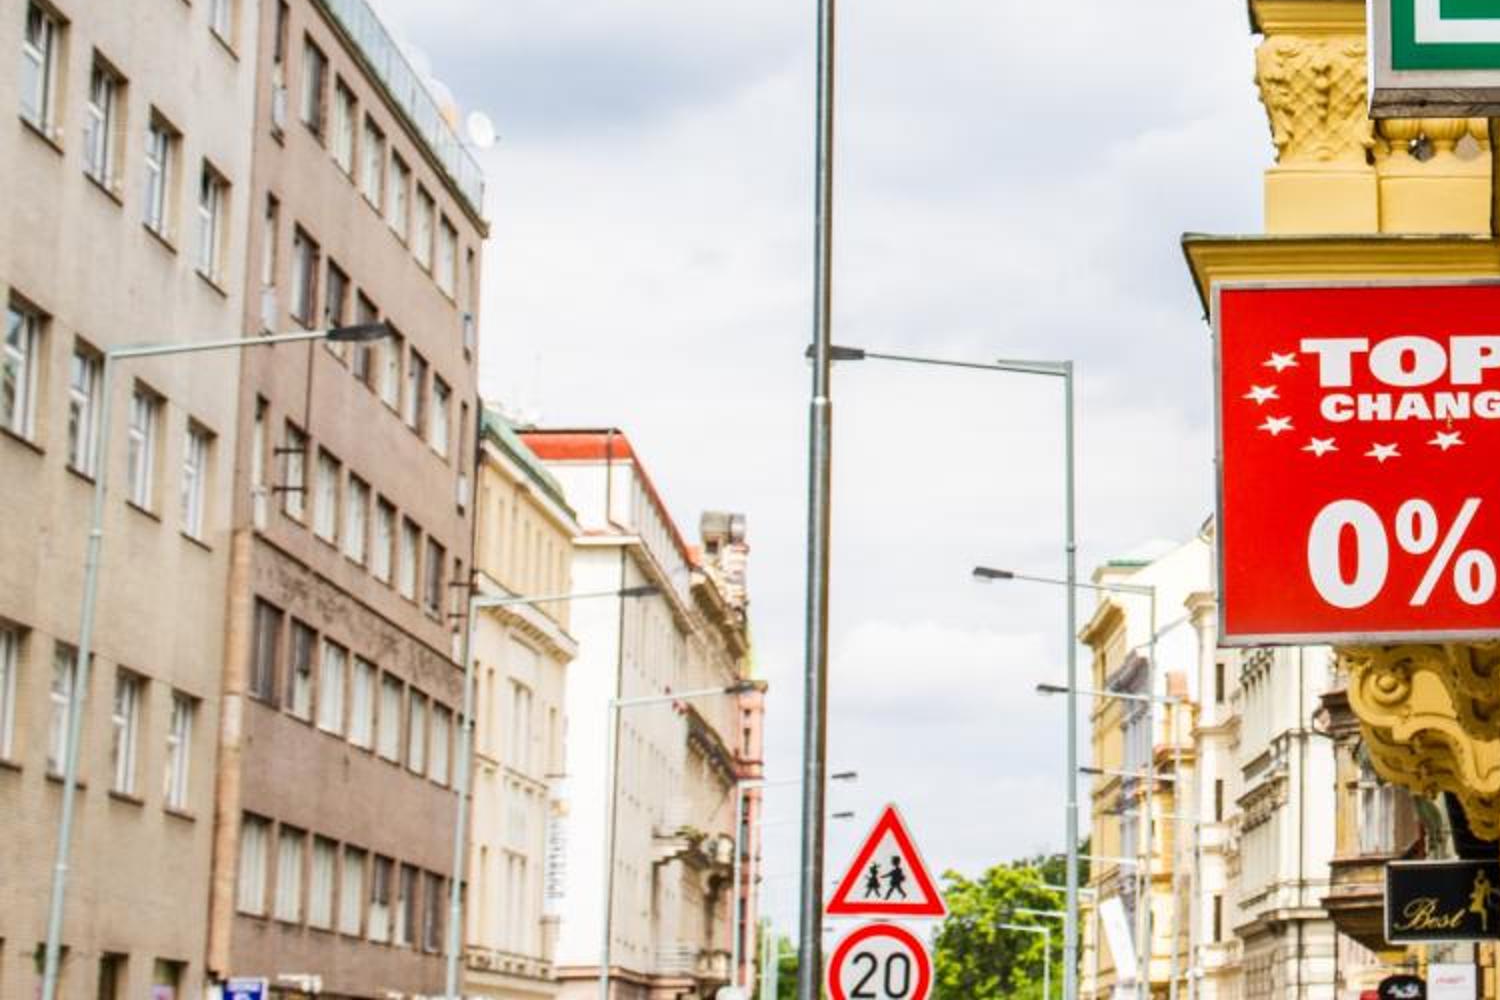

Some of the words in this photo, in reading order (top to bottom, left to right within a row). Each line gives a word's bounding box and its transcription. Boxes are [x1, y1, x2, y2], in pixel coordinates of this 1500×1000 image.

[1307, 498, 1497, 609] 0%
[1393, 896, 1468, 931] Best
[851, 951, 911, 999] 20
